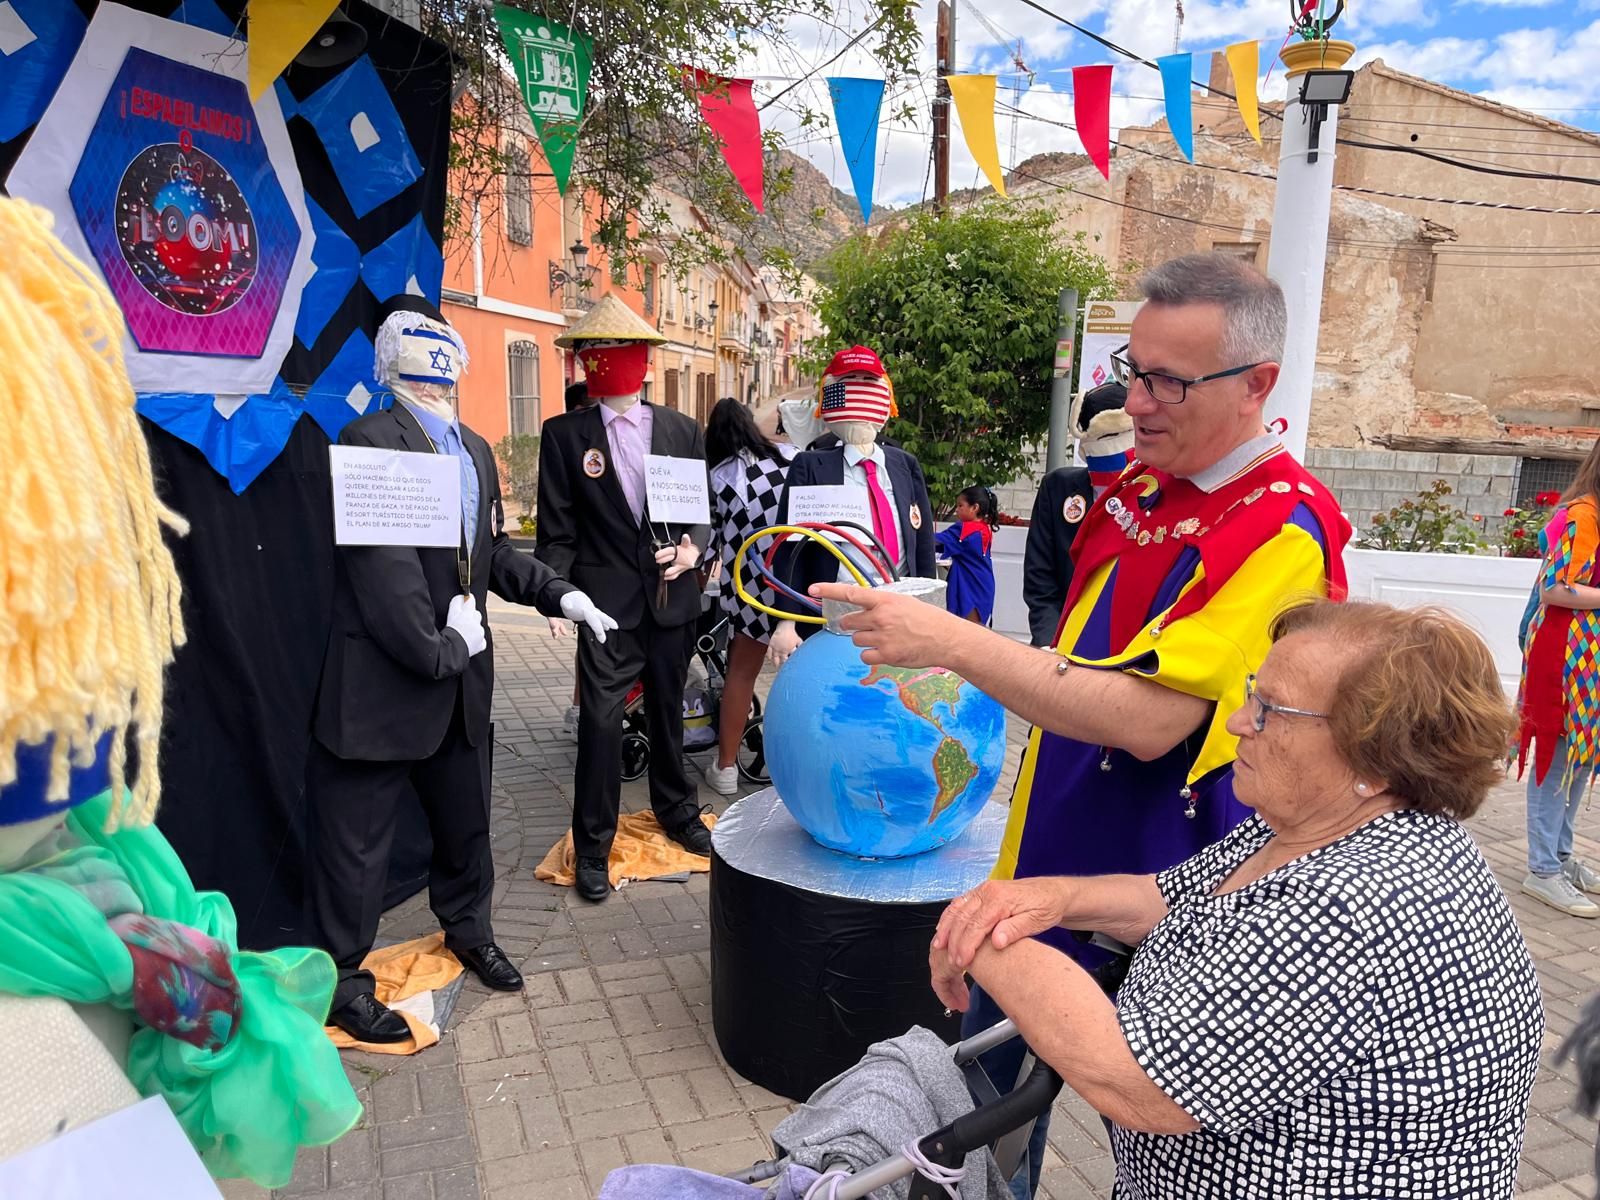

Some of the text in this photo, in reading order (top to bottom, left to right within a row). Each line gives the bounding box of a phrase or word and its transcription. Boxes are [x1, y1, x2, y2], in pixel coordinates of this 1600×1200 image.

[178, 129, 193, 153] O
[362, 474, 392, 482] HACEMOS
[656, 482, 688, 491] NOSOTROS
[652, 494, 701, 504] FALTA EL BIGOTE
[845, 512, 866, 520] CORTO
